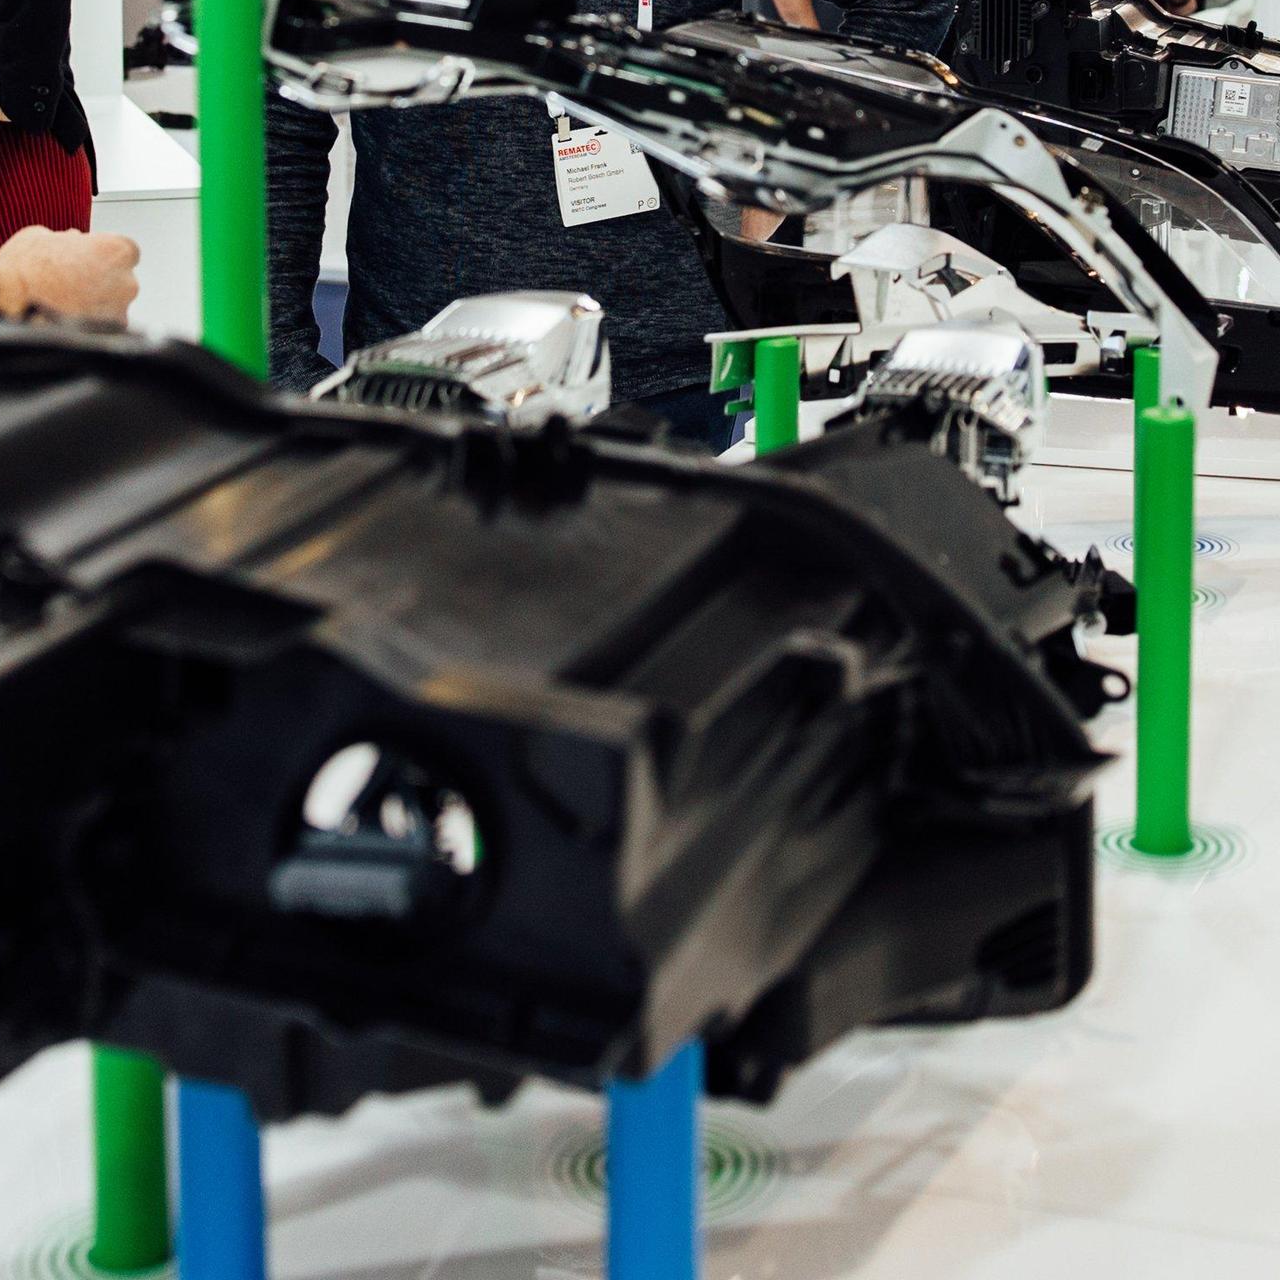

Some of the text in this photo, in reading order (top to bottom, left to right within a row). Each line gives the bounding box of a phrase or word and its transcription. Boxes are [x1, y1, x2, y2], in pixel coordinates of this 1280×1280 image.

[558, 143, 597, 157] REMATEC
[566, 165, 590, 174] Michael
[568, 174, 588, 183] Robert
[571, 196, 595, 206] VISITOR
[638, 200, 645, 210] P
